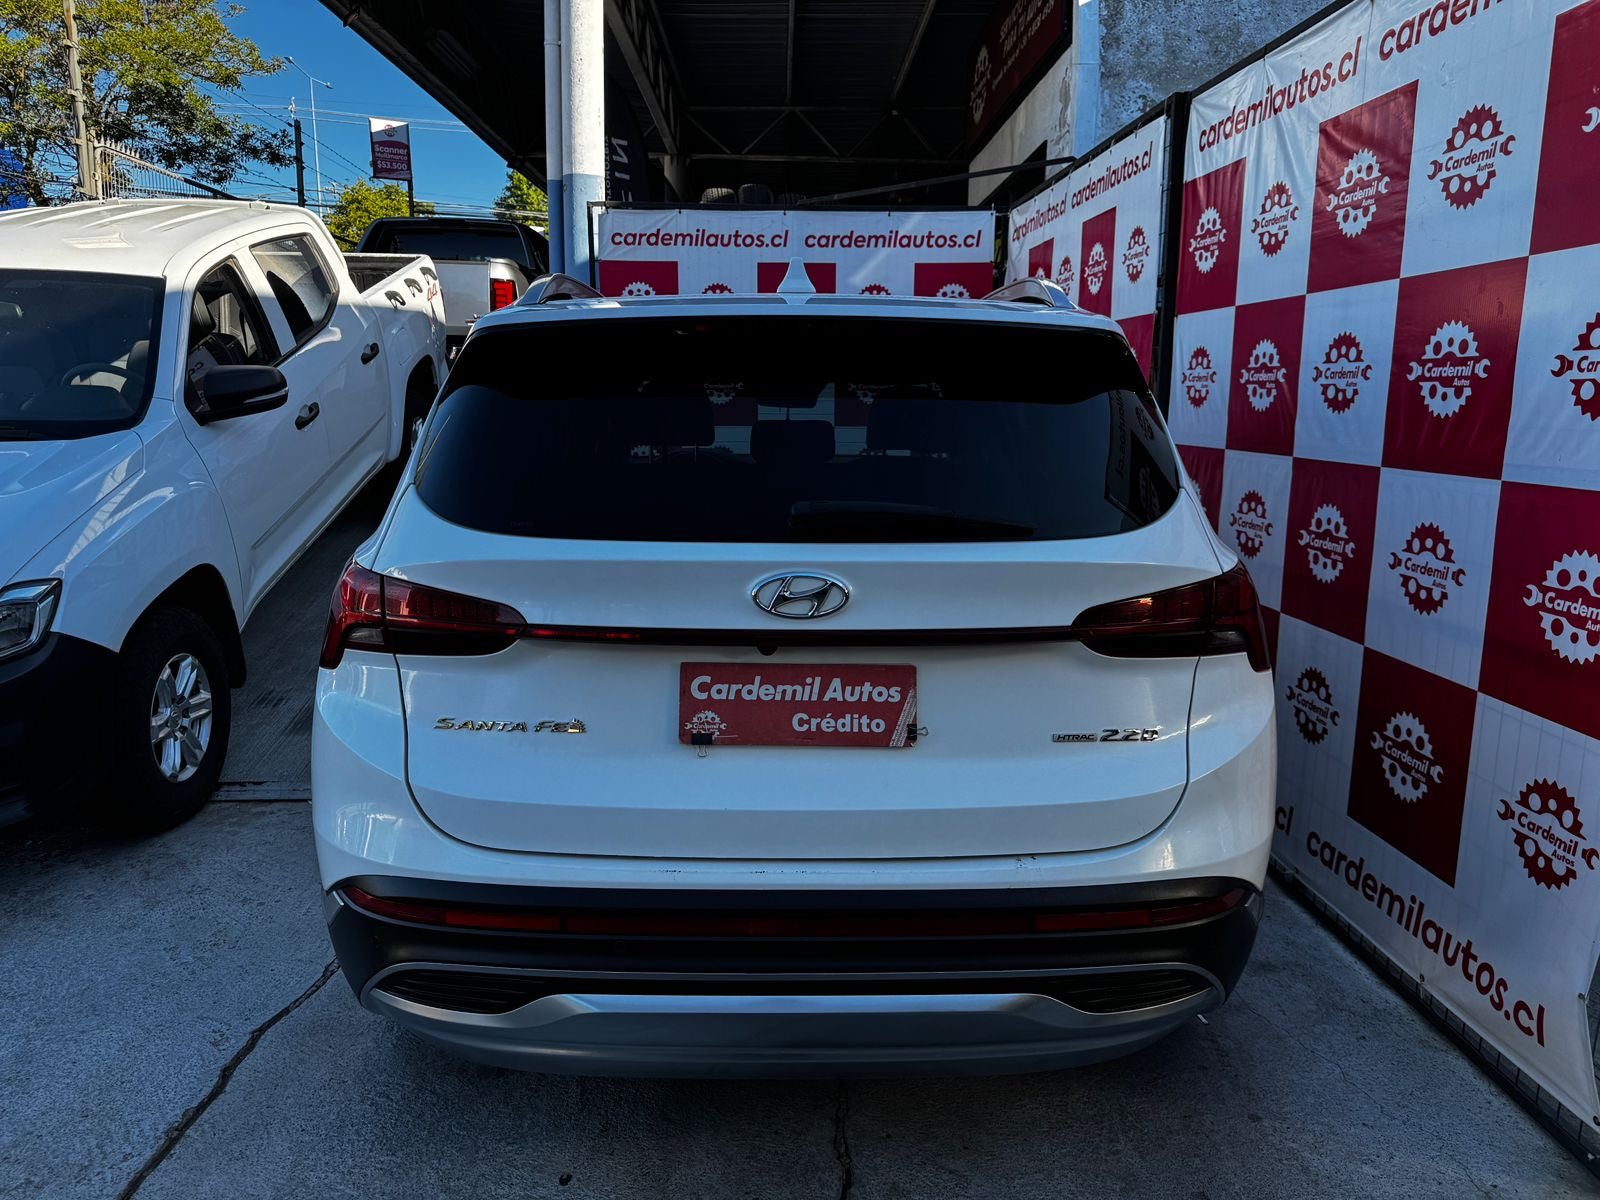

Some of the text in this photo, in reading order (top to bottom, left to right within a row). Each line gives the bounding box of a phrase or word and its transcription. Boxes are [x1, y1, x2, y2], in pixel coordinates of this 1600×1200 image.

[1199, 35, 1362, 152] cardemilautos.cl
[374, 143, 407, 155] Scanner
[1445, 140, 1498, 172] Cardemil
[1072, 141, 1153, 209] cardemilautos.cl
[1476, 161, 1494, 173] Autos
[1338, 180, 1378, 205] Cardemil
[1260, 209, 1289, 229] Cardemil
[611, 228, 982, 249] cardemilautos.cl cardemilautos.cl
[1250, 368, 1277, 382] Cardemil
[1324, 365, 1361, 380] Cardemil
[1424, 360, 1474, 378] Cardemil
[1237, 516, 1266, 532] Cardemil
[1310, 534, 1345, 554] Cardemil
[1404, 556, 1450, 581] Cardemil
[690, 675, 902, 702] Cardemil Autos
[1296, 692, 1331, 720] Cardemil
[433, 717, 528, 732] SANTA
[792, 711, 886, 733] Crédito
[1056, 733, 1095, 741] HTRAC
[1384, 741, 1430, 774] Cardemil
[1517, 812, 1579, 857] Cardemil
[1551, 849, 1575, 867] Autos
[1307, 831, 1546, 1048] cardemilautos.cl
